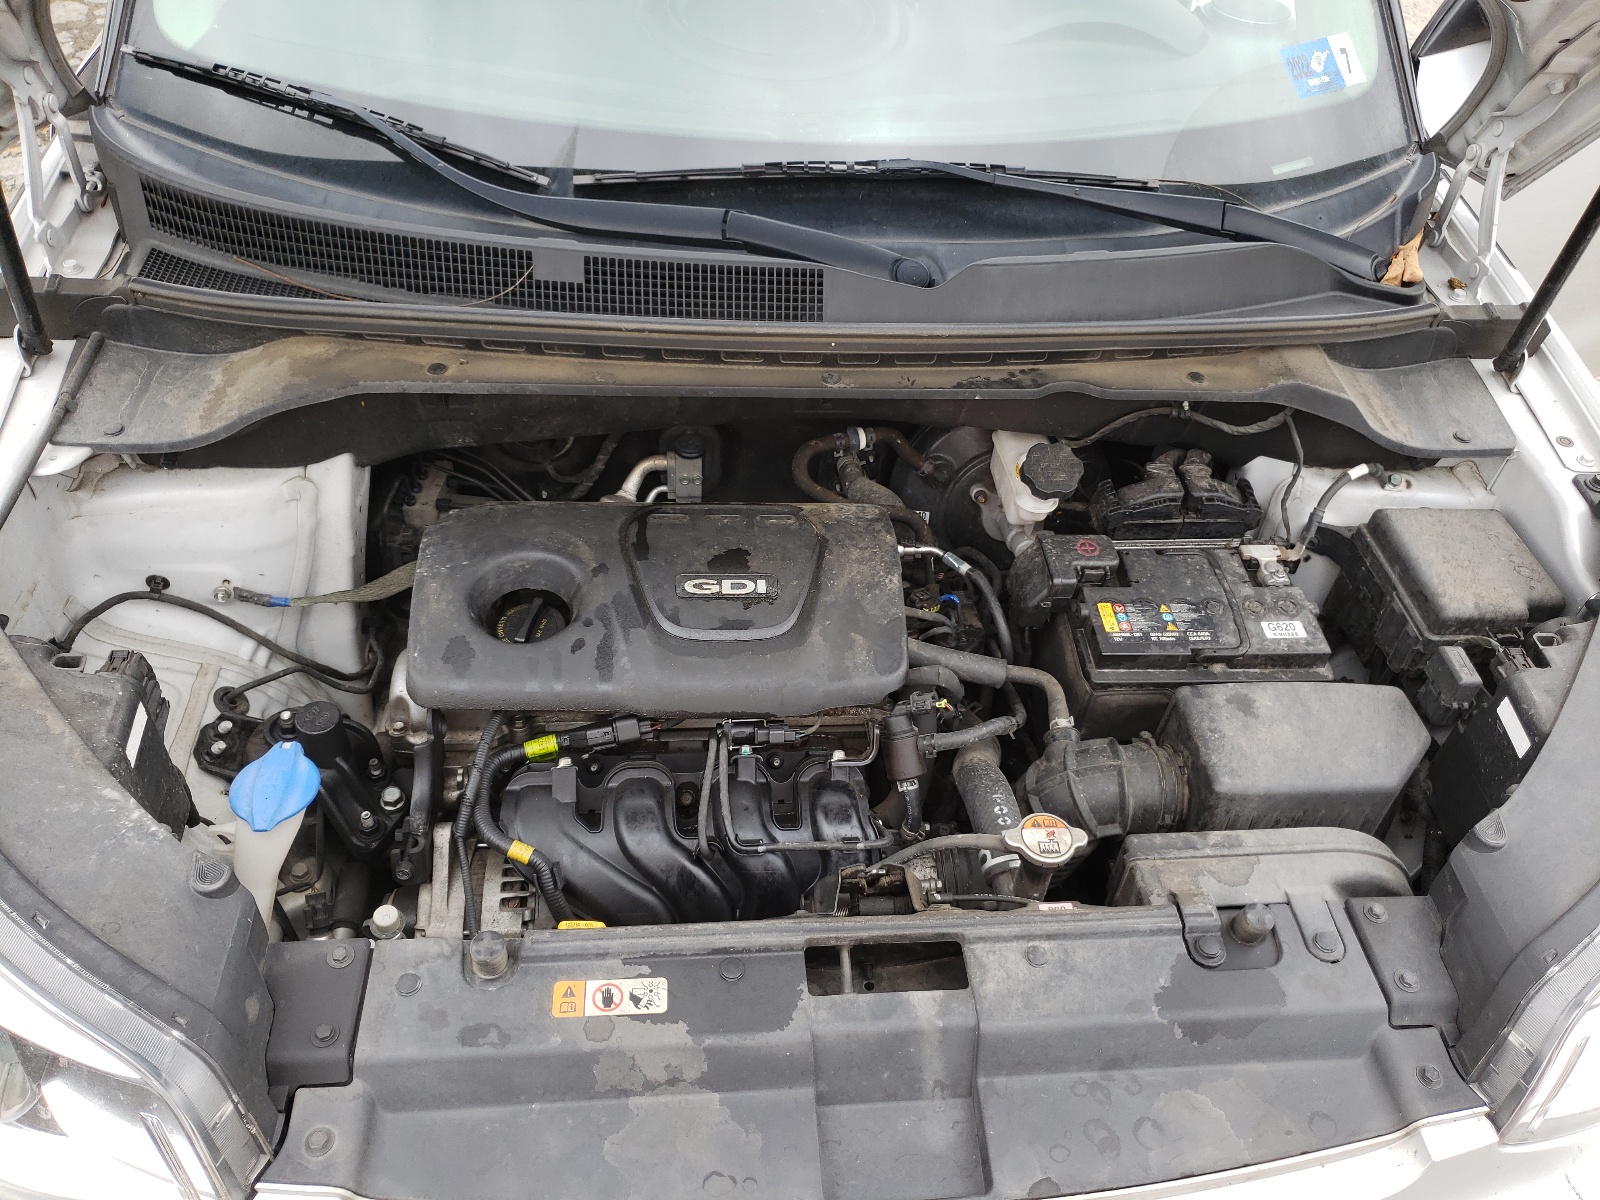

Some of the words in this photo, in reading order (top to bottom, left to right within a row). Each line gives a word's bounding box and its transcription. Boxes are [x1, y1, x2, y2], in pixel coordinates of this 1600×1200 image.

[1286, 54, 1314, 80] 2022
[684, 578, 767, 595] GDI
[1267, 622, 1296, 632] G620
